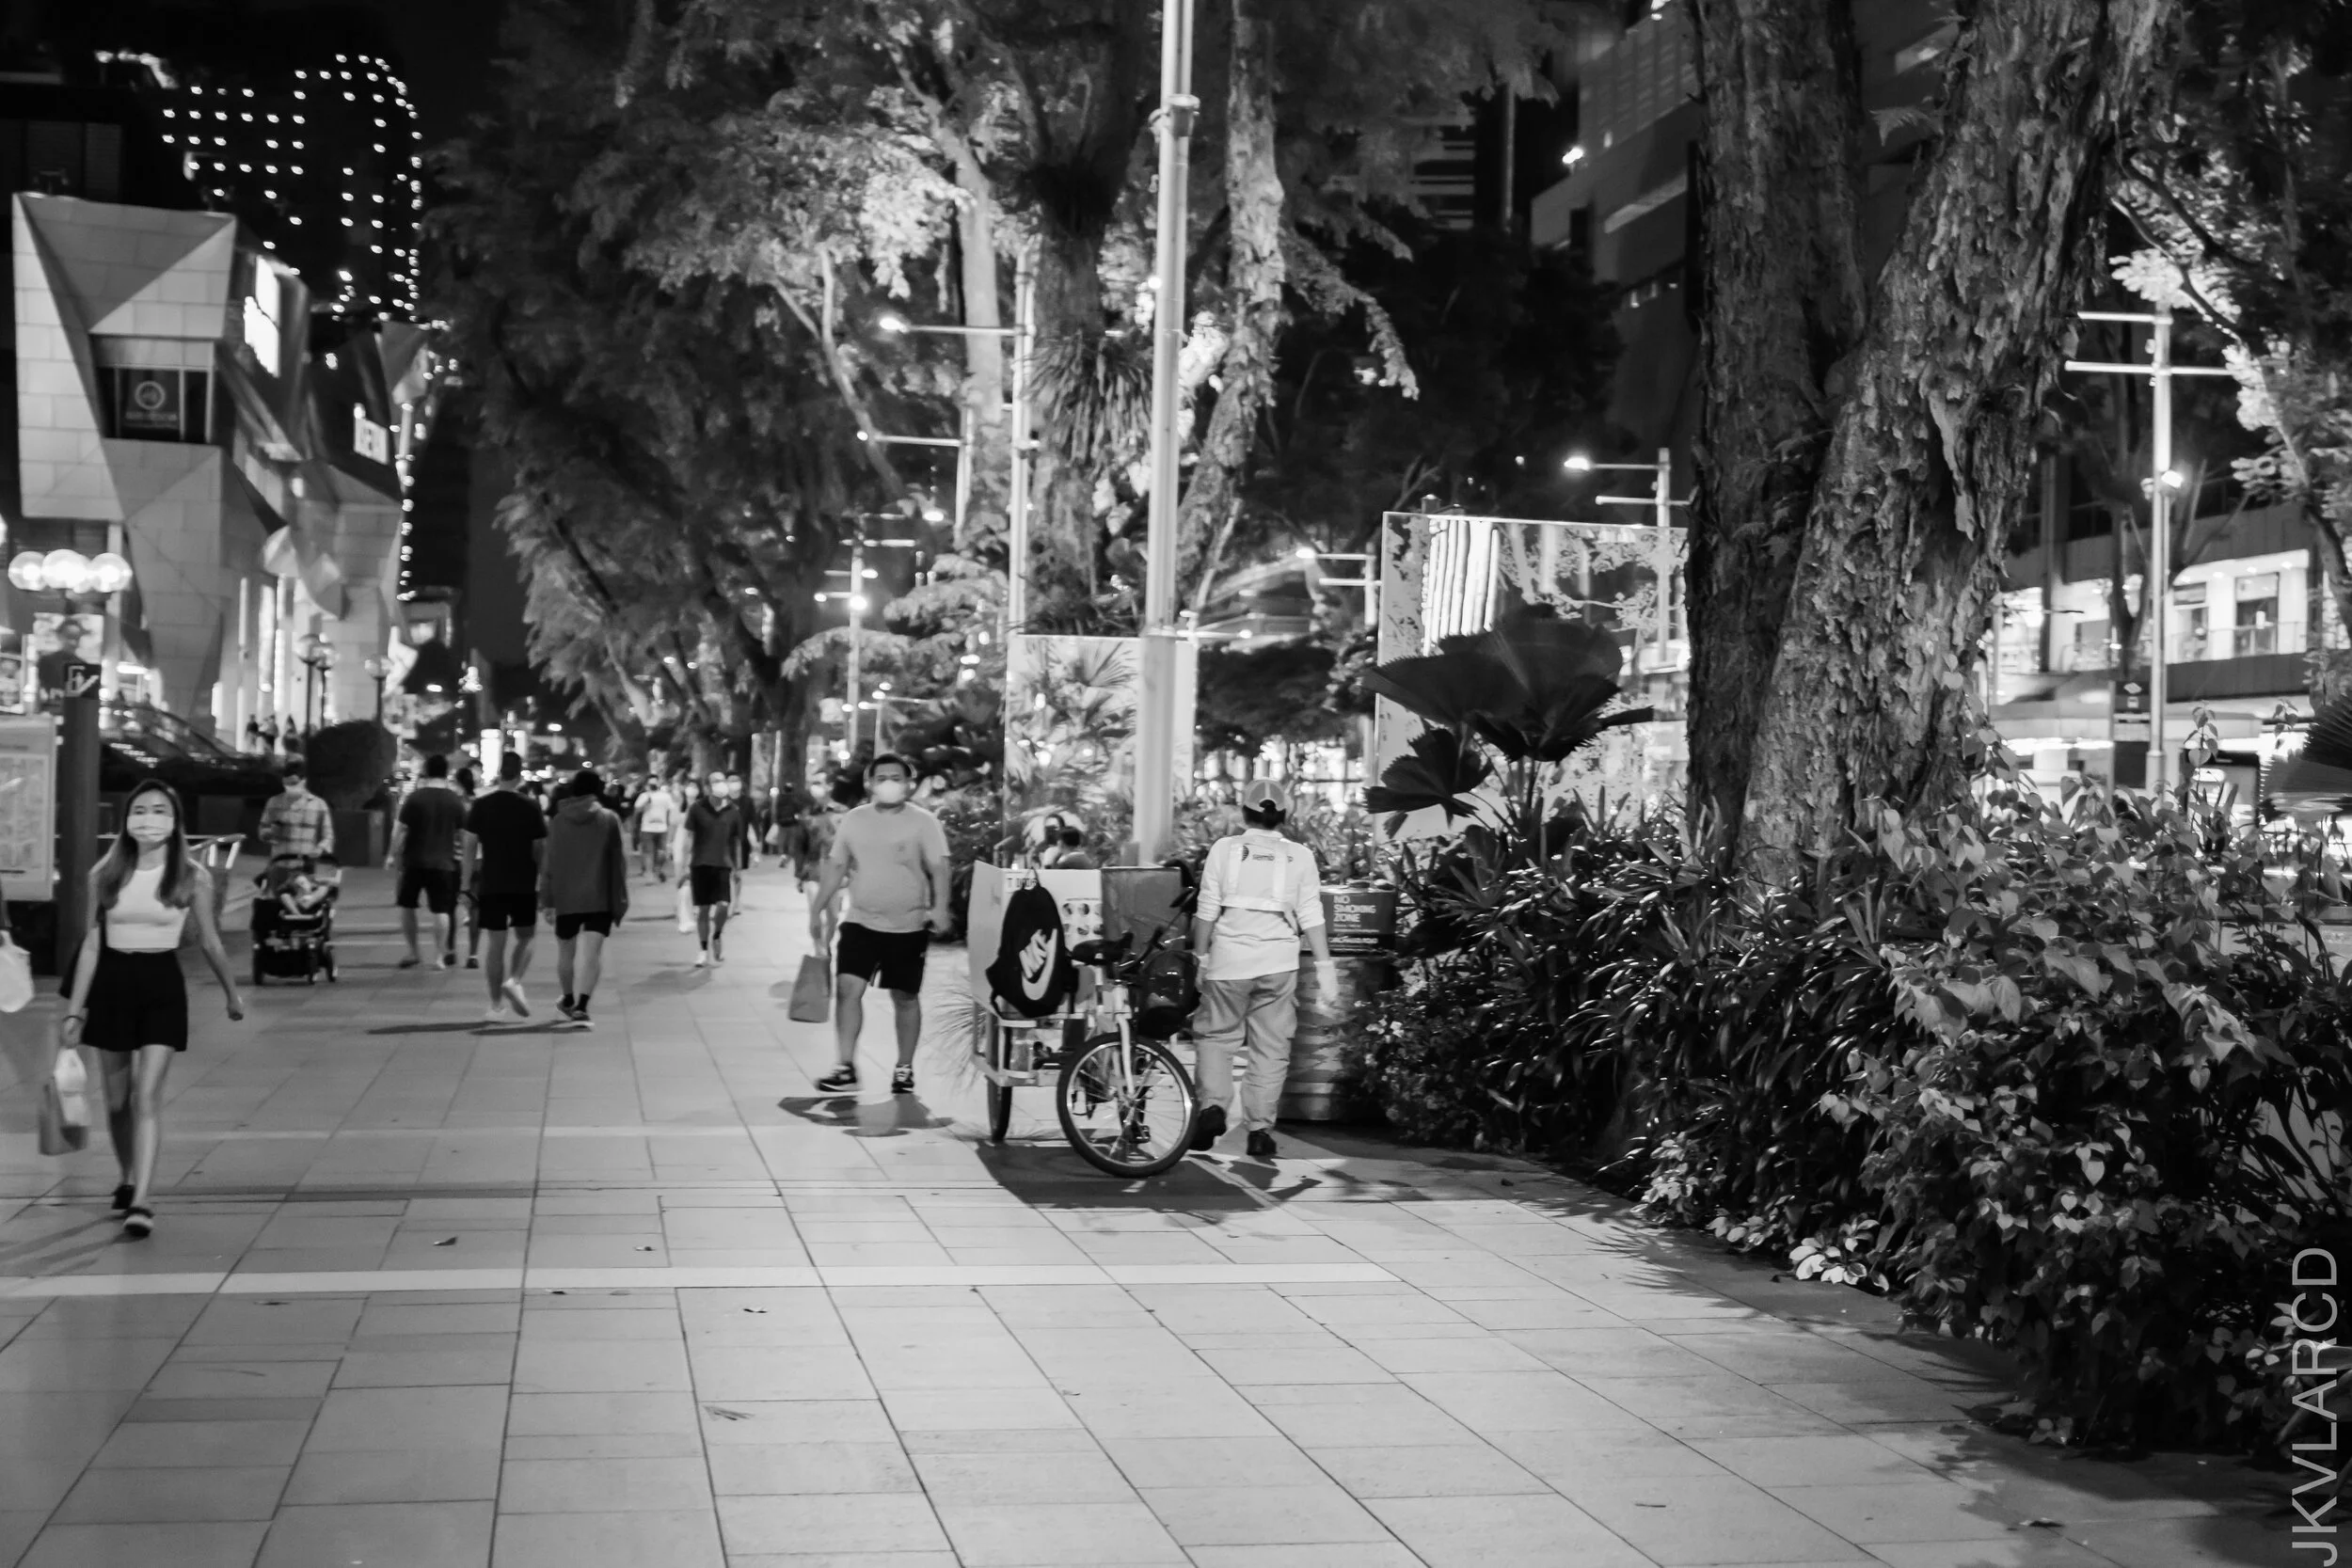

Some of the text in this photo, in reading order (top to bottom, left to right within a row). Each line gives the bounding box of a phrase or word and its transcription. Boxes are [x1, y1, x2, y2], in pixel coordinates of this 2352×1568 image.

[1333, 895, 1351, 904] NO
[1333, 904, 1376, 913] SMOKING
[1333, 913, 1360, 923] ZONE
